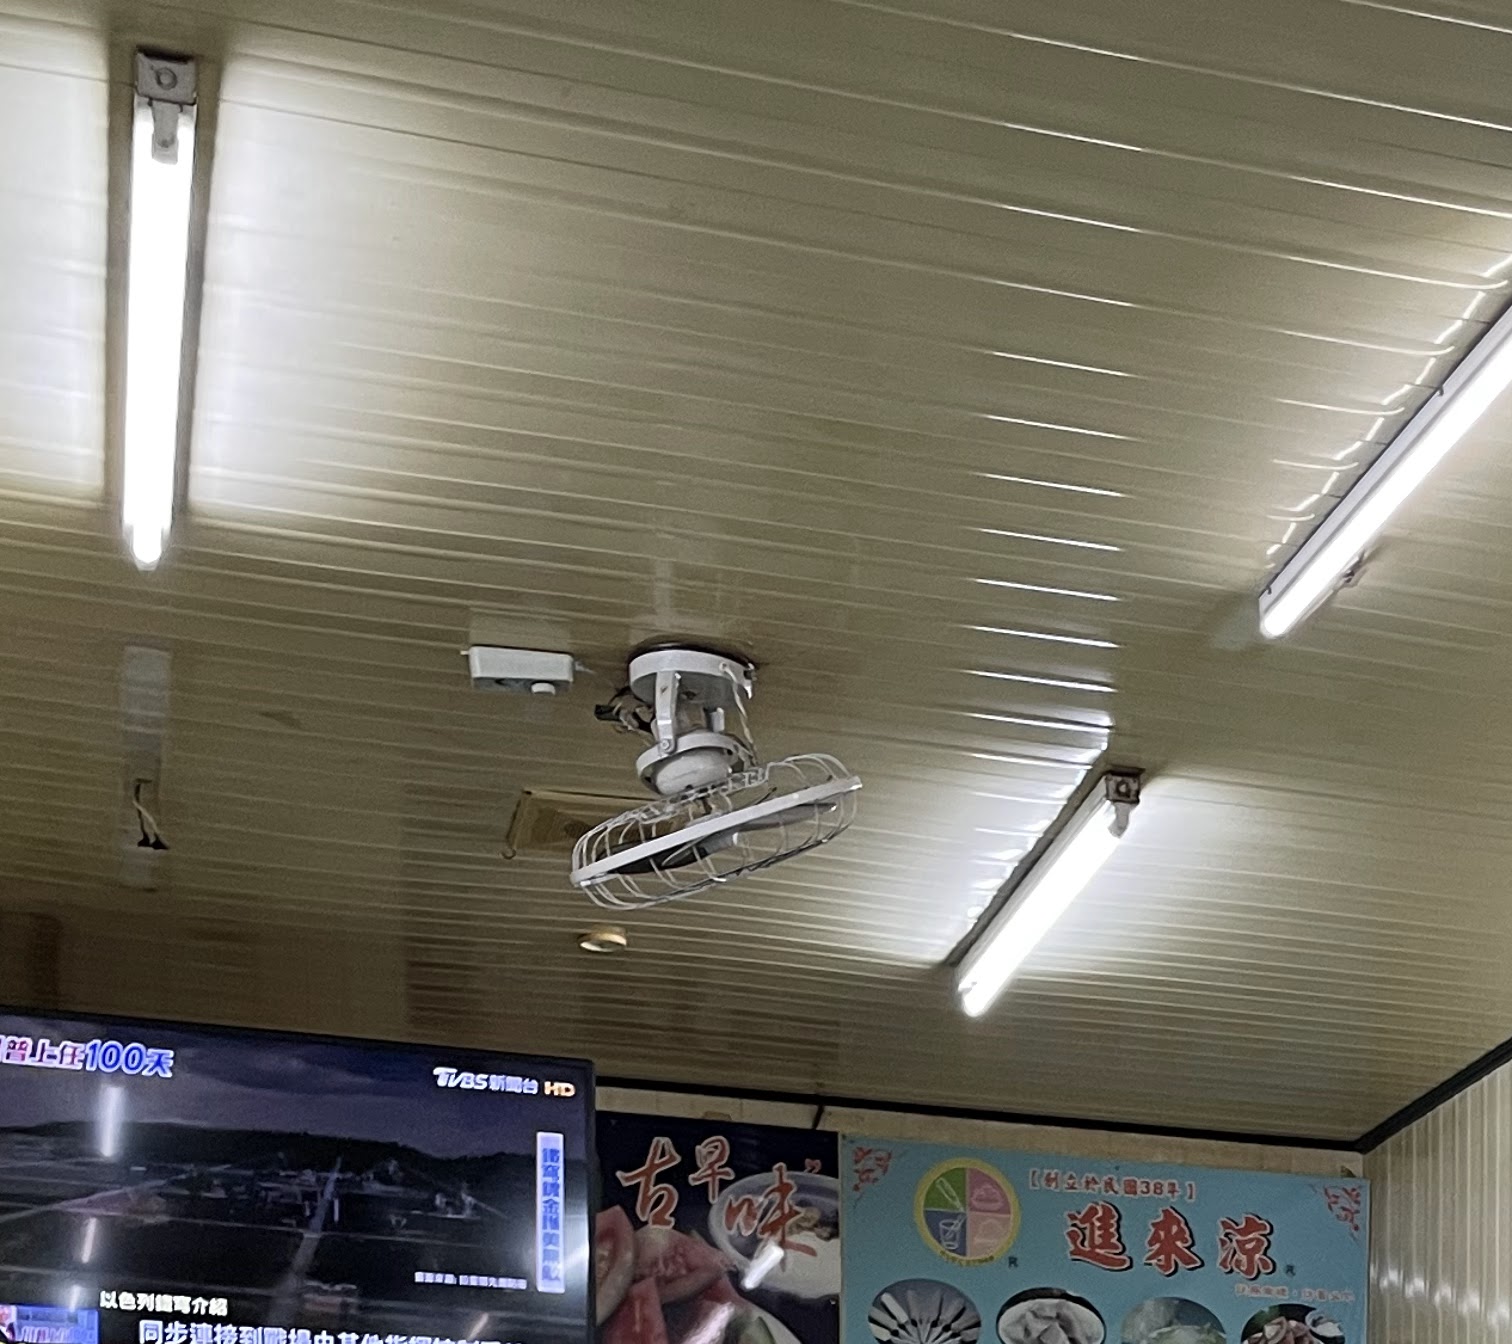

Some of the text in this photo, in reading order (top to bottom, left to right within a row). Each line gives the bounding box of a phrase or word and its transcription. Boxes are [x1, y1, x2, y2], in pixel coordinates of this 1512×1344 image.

[0, 1034, 174, 1077] 普上任100天
[544, 1081, 576, 1097] HD
[1065, 1201, 1276, 1280] 進來涼
